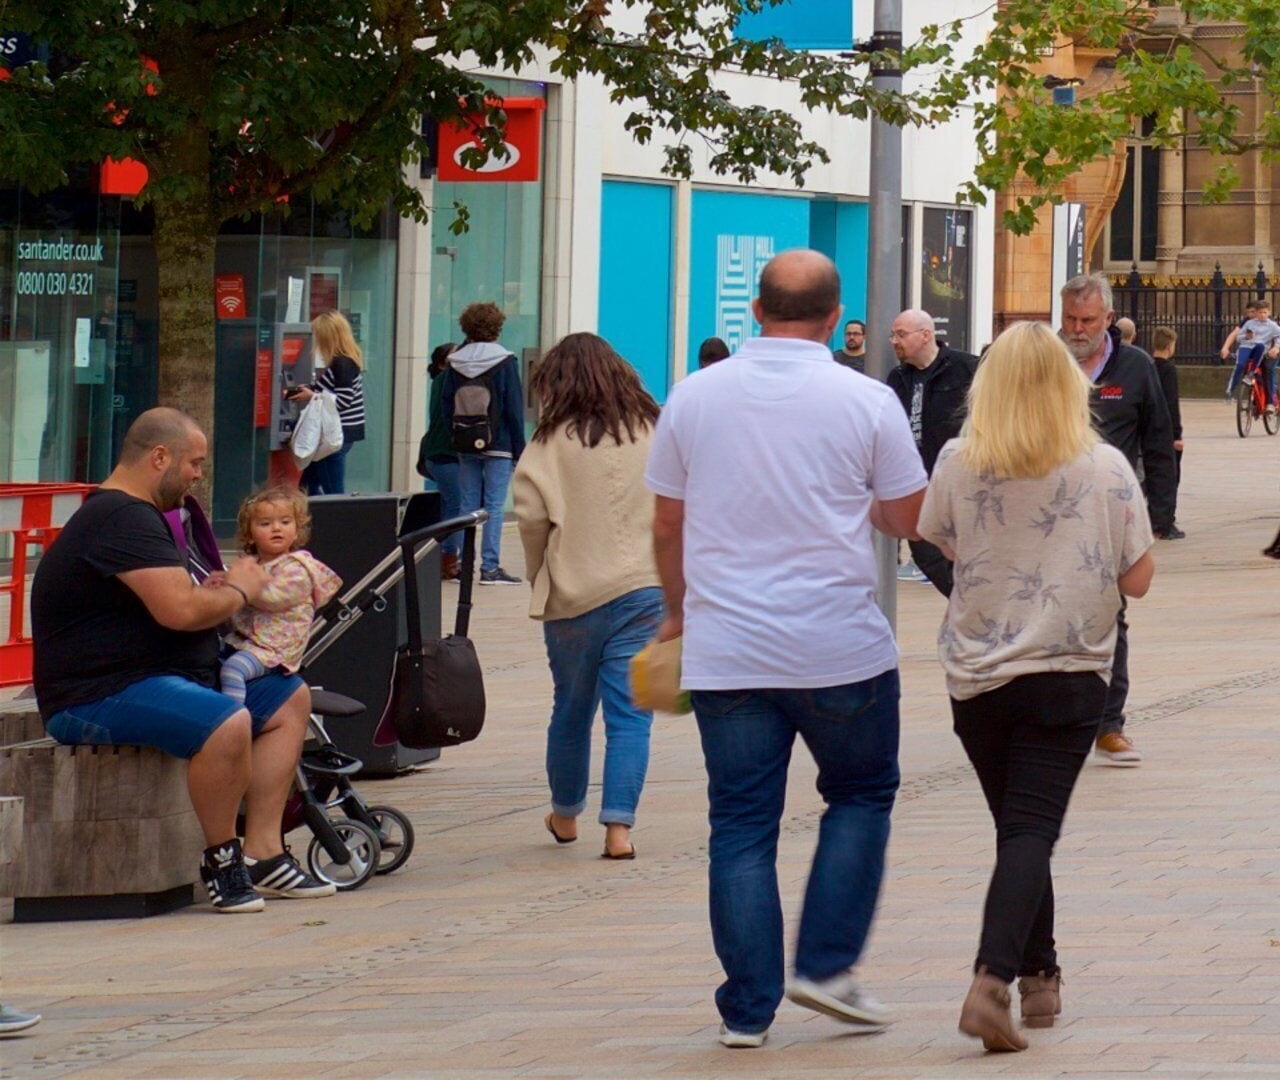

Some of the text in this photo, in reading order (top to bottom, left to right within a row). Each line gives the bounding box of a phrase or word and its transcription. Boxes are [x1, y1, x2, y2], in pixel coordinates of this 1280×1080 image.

[18, 237, 103, 261] santander.co.uk
[18, 272, 93, 295] 0800 030 4321
